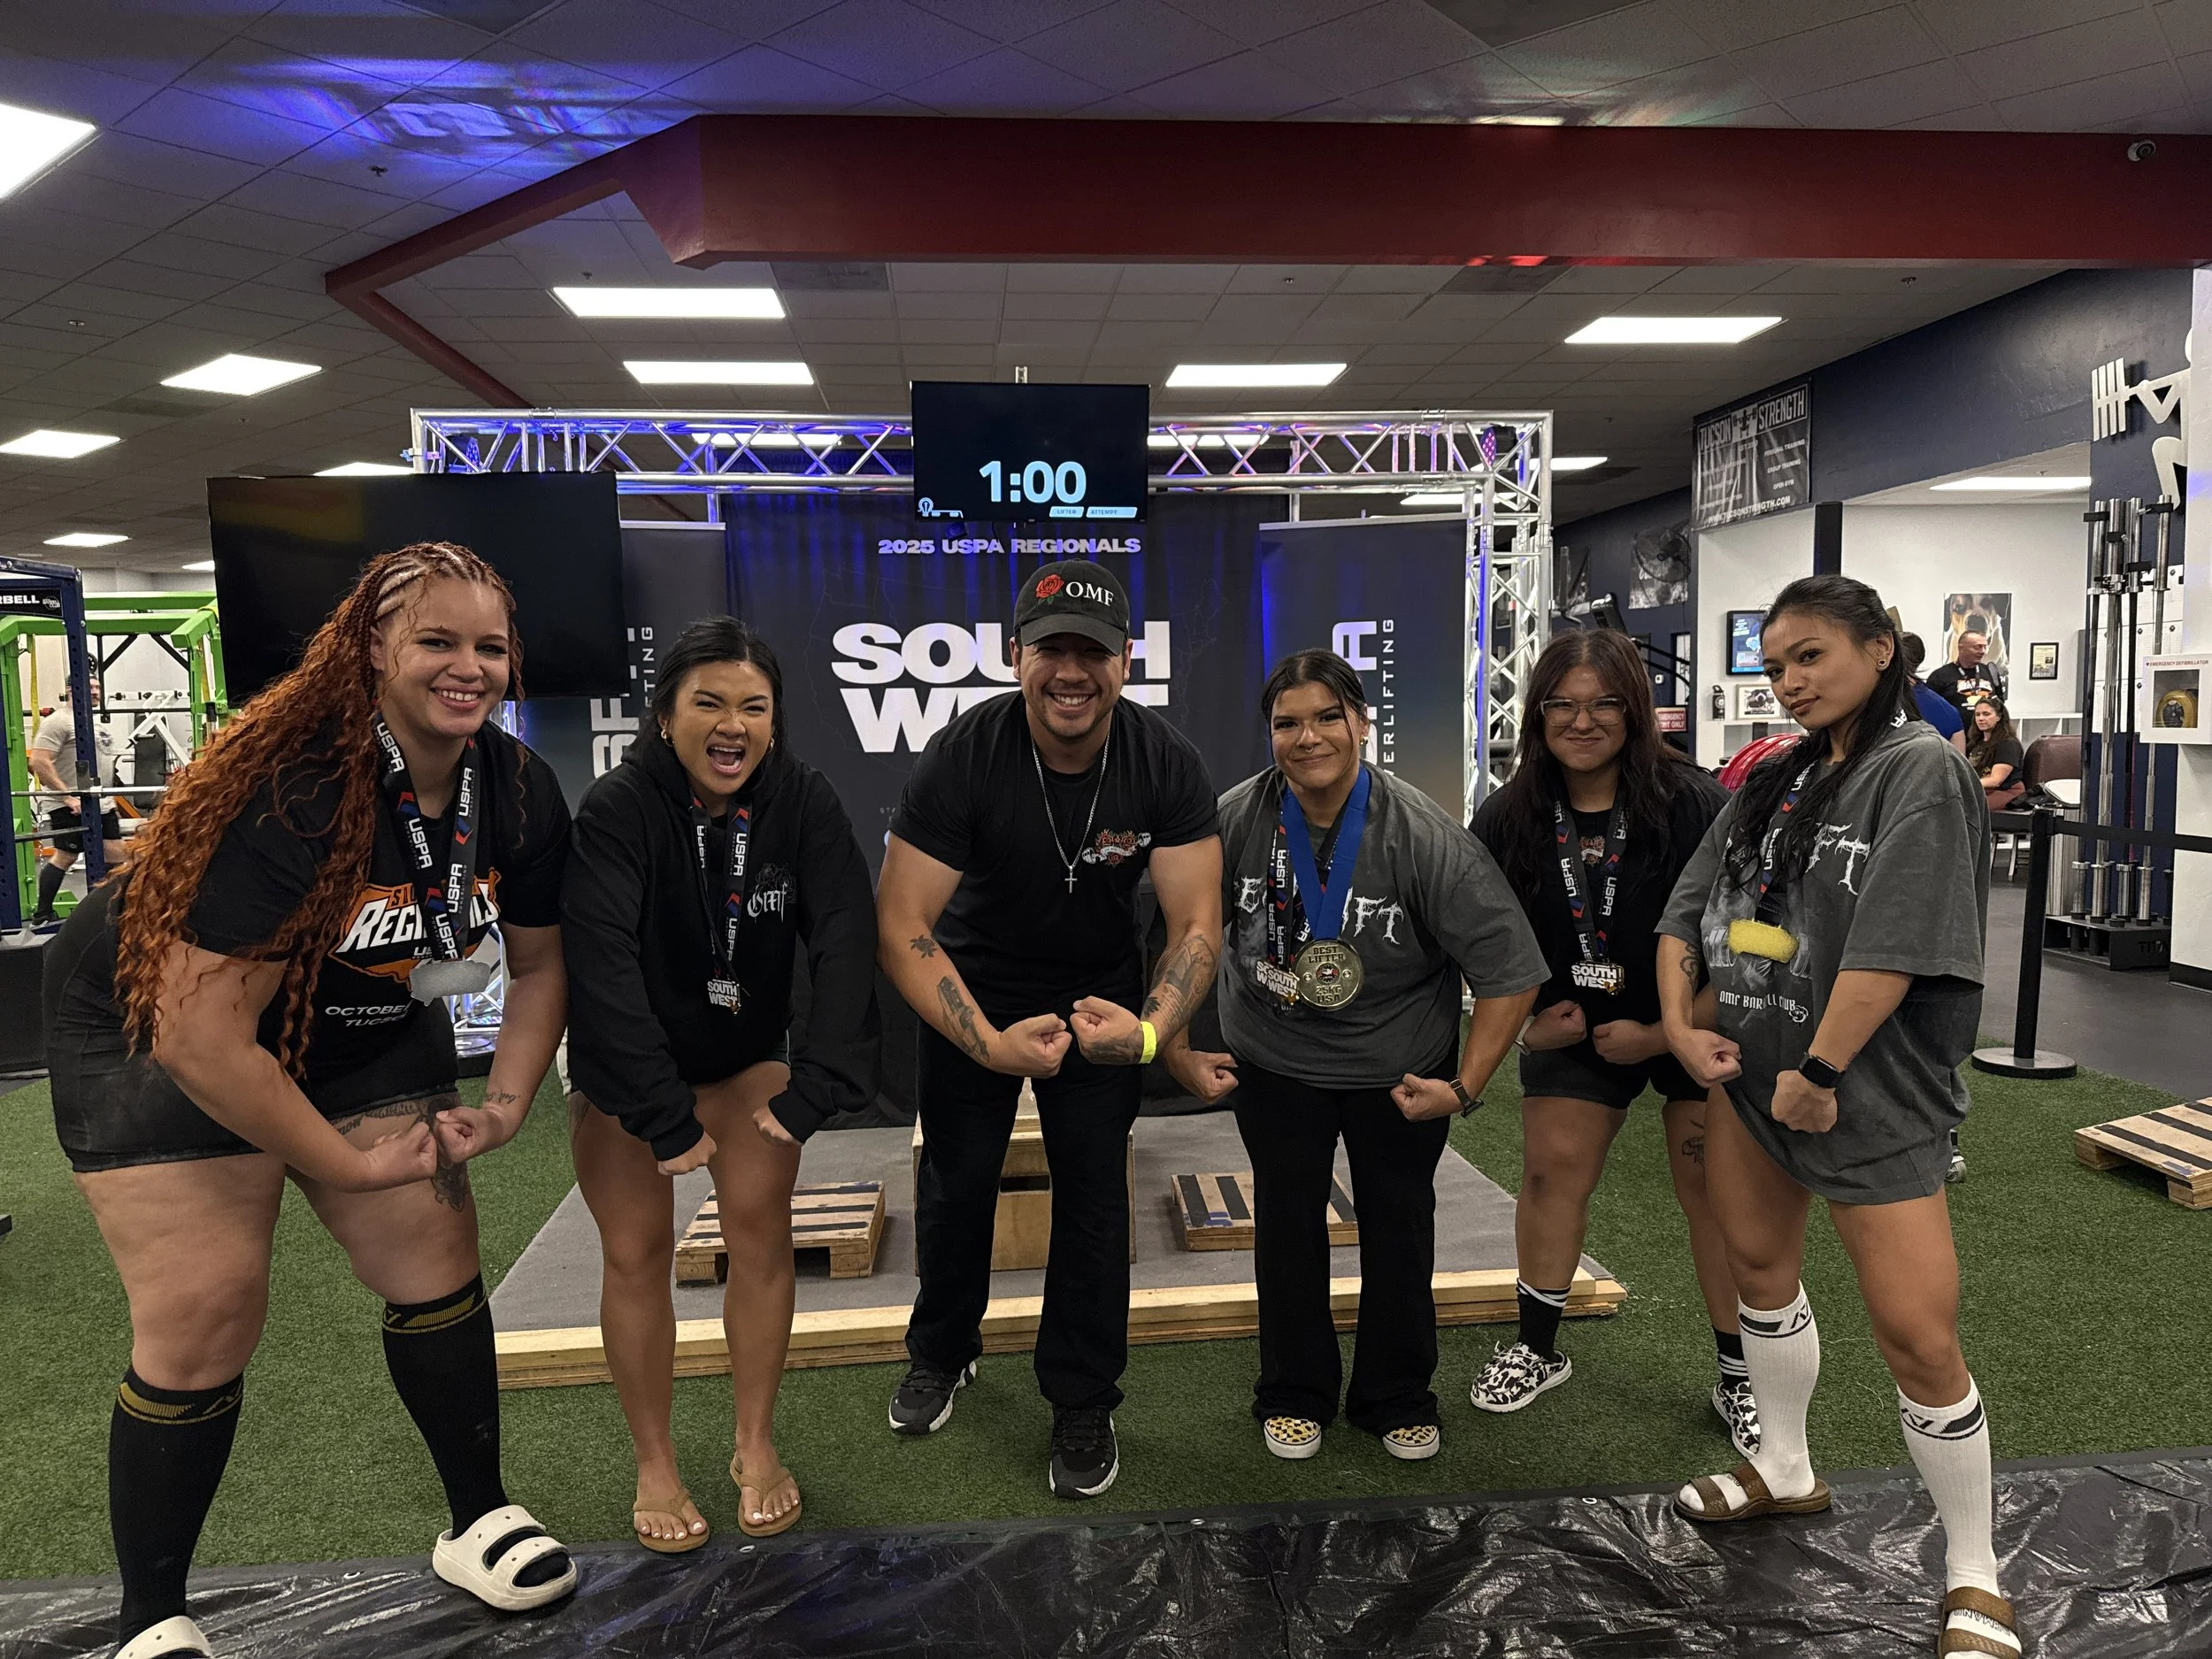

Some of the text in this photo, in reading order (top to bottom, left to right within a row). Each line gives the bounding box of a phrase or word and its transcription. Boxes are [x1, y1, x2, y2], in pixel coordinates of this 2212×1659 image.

[1700, 389, 1805, 450] TUCSON STRENGTH
[1785, 439, 1806, 450] TRAINING
[1782, 458, 1801, 470] TRAINING
[979, 460, 1087, 503] 1:00
[1773, 481, 1784, 490] OPEN
[878, 538, 1141, 554] 2025 USPA REGIONALS
[1065, 581, 1114, 607] OMF
[831, 620, 1171, 684] SOUH
[376, 722, 404, 772] USPA
[458, 767, 472, 817] USPA
[408, 818, 433, 869] USPA
[733, 833, 747, 877] USPA
[1277, 849, 1286, 888] USPA
[1561, 857, 1577, 897] USPA
[447, 864, 463, 913] USPA
[1601, 877, 1617, 916] USPA
[1308, 954, 1346, 964] LIFTER
[1313, 946, 1338, 955] BEST
[1268, 969, 1297, 989] SOUTH
[1571, 964, 1617, 979] SOUTH
[707, 980, 738, 996] SOUTH
[1268, 979, 1296, 998] WEST
[1316, 985, 1342, 995] 25KG
[1573, 974, 1617, 989] WEST
[709, 991, 738, 1007] WEST
[1317, 993, 1340, 1004] USA
[345, 1014, 407, 1026] TUCSO
